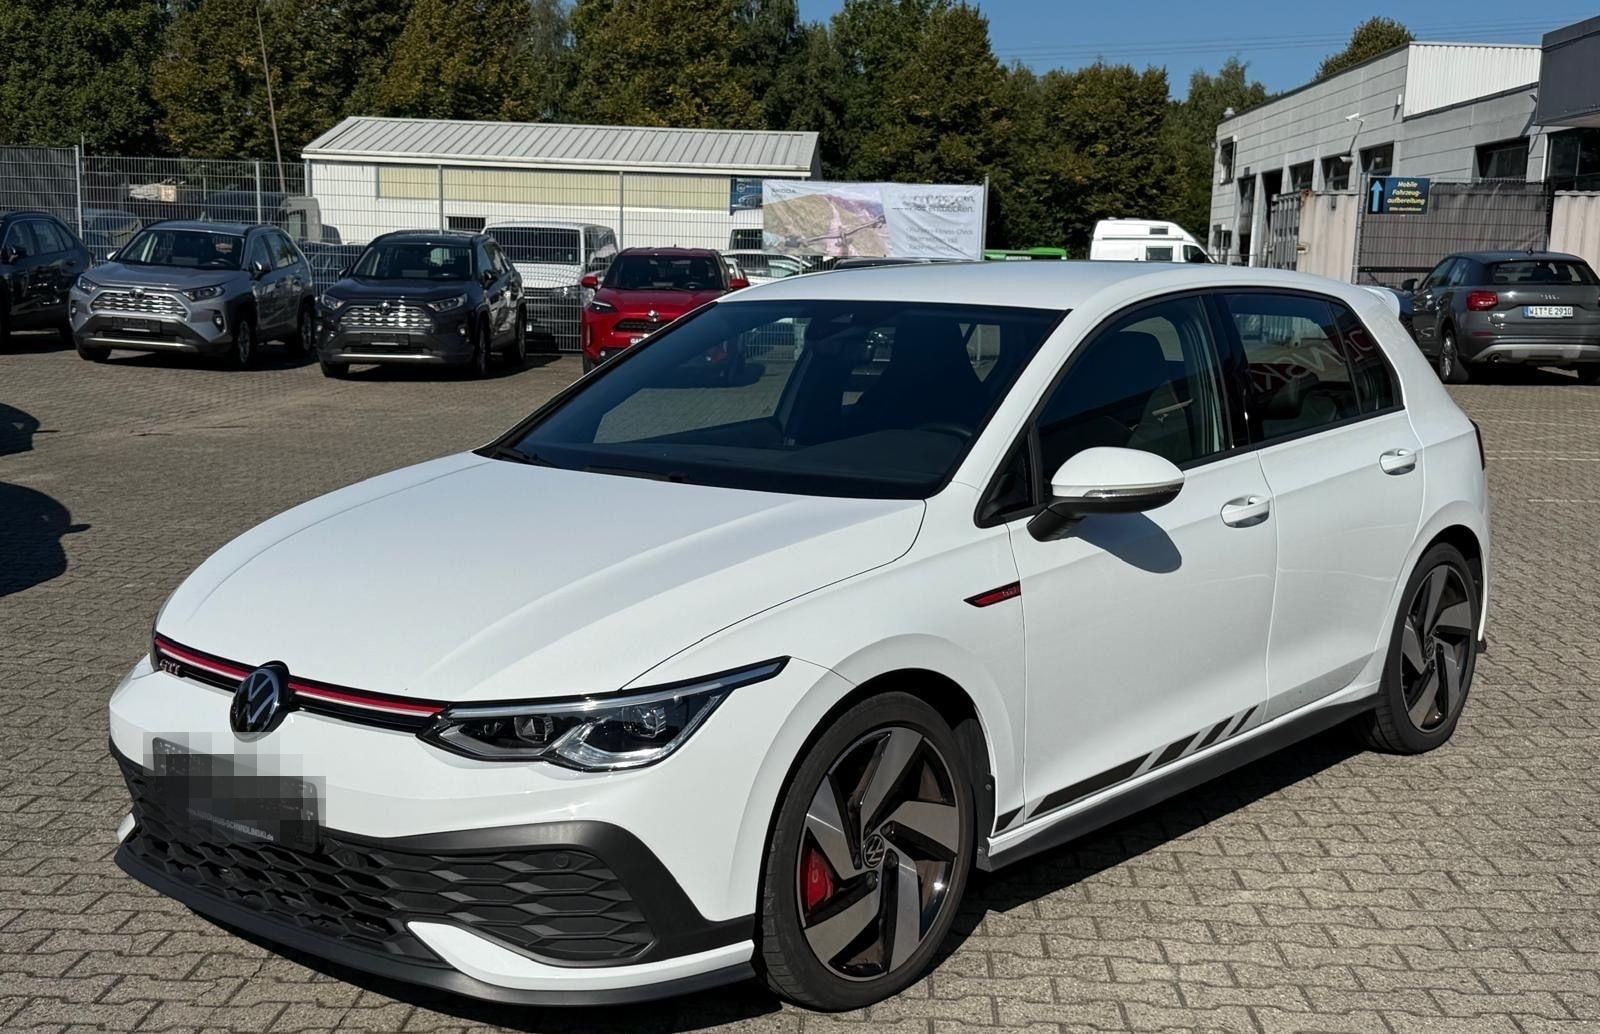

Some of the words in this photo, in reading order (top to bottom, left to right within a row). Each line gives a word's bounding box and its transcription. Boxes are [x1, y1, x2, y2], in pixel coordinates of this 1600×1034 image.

[1392, 189, 1422, 197] Fahrzeug-
[1386, 197, 1426, 206] aufbereitung
[1528, 307, 1543, 316] WIT
[1554, 307, 1572, 316] 2910
[159, 658, 181, 676] GTI
